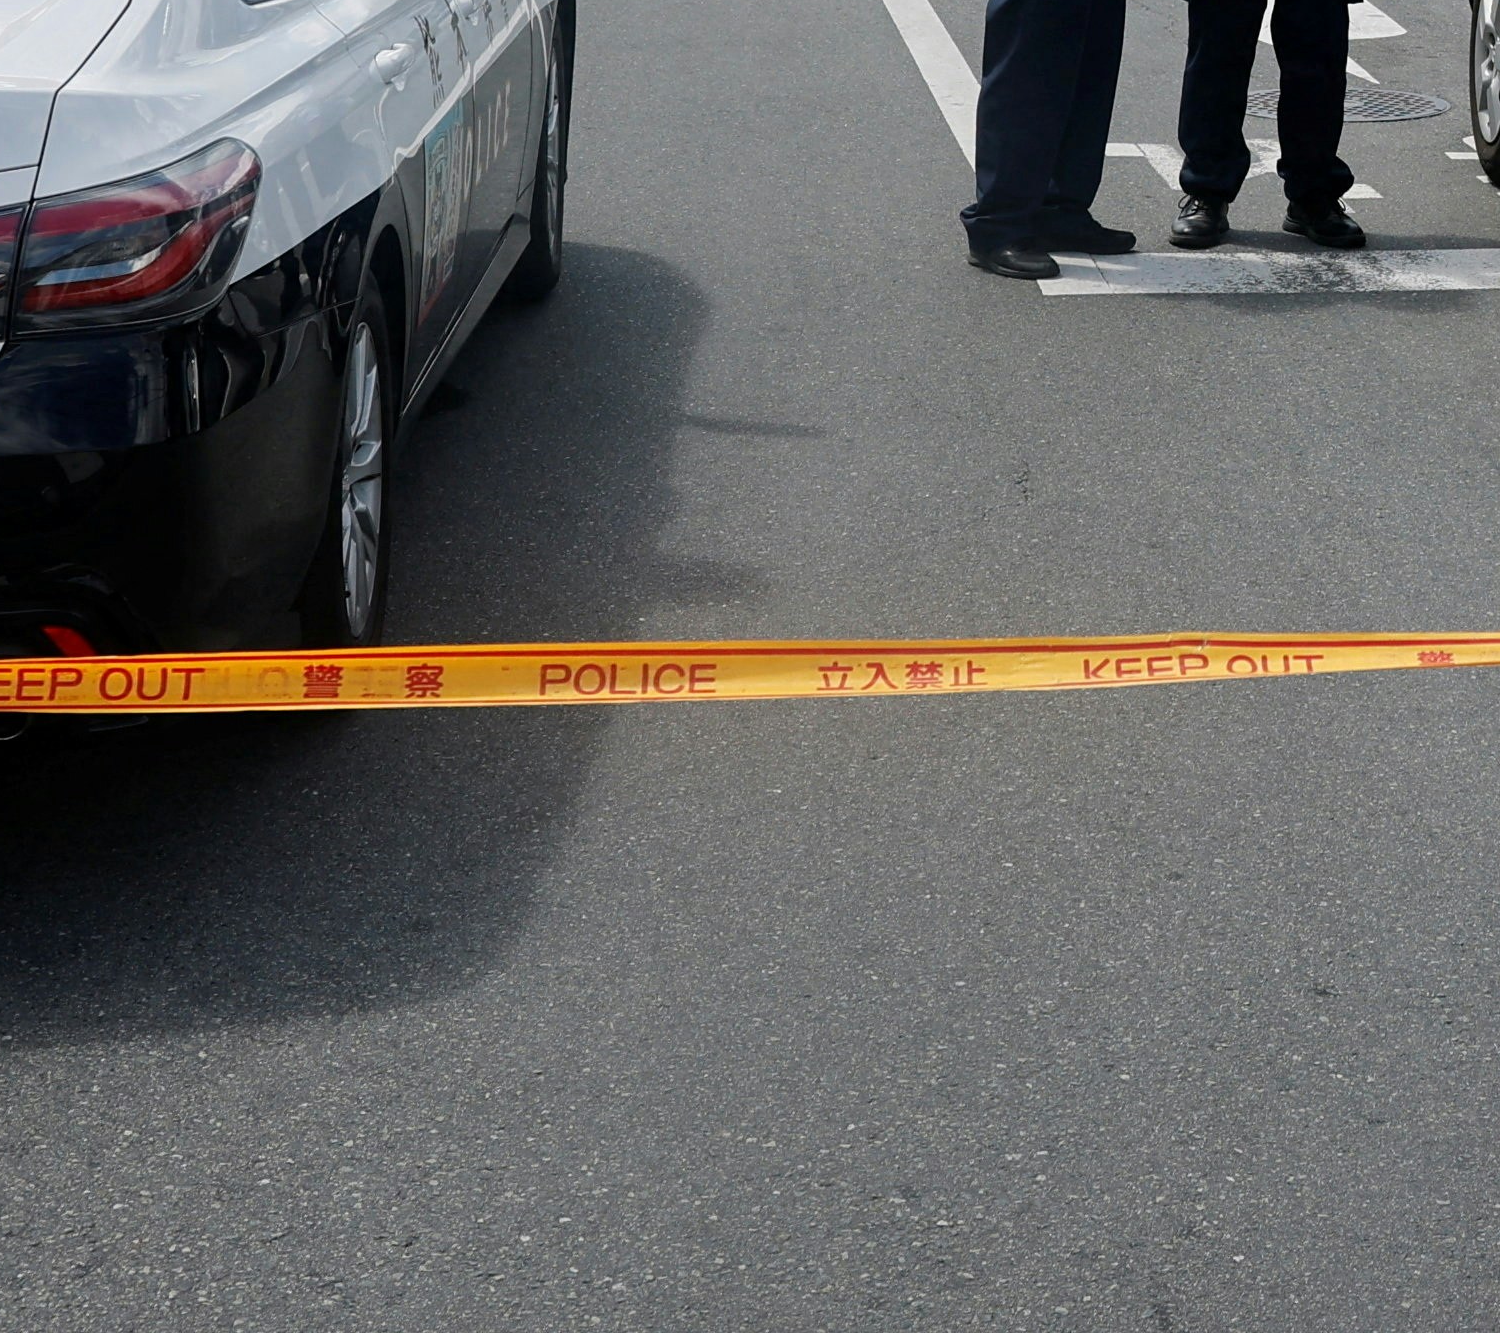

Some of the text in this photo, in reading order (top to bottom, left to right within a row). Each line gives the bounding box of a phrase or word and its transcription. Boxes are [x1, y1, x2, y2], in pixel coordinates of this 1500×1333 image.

[97, 666, 207, 702] OUT
[538, 662, 718, 697] POLICE
[815, 660, 988, 692] 立入禁止
[1082, 653, 1209, 681] KEEP
